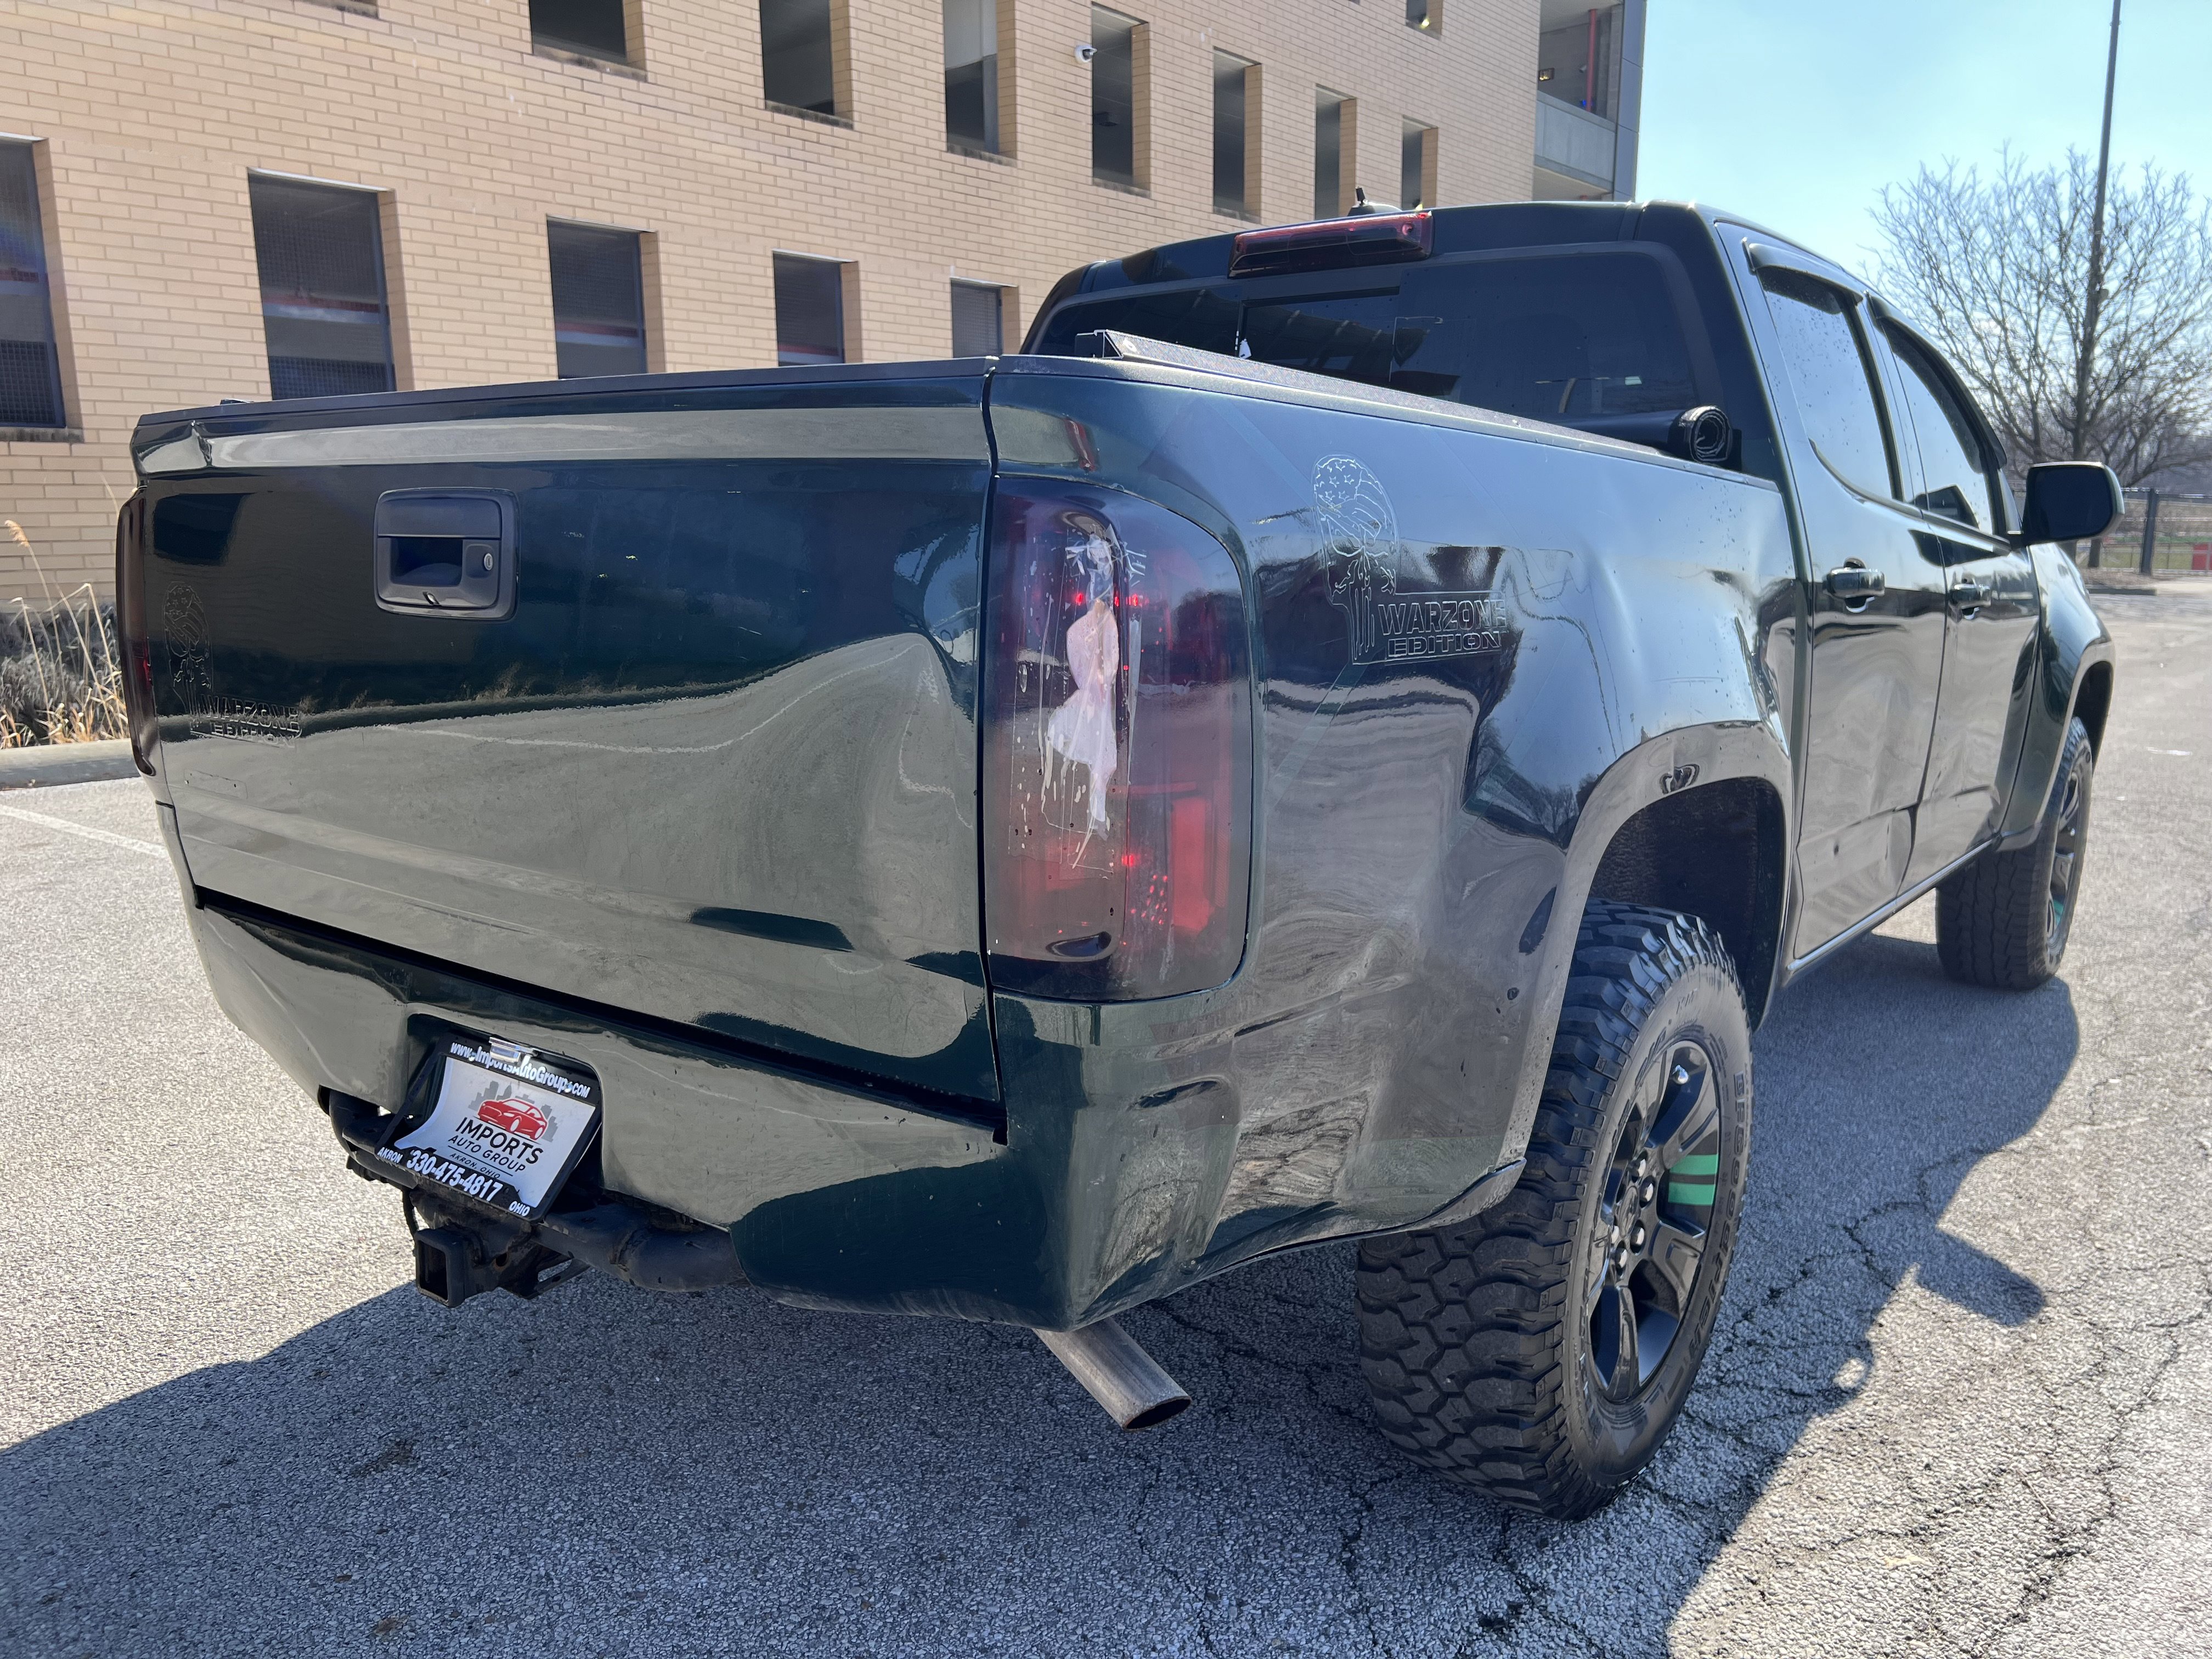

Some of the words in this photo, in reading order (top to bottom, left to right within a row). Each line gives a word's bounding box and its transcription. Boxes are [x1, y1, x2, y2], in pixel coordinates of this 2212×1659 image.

[1378, 599, 1507, 636] WARZONE
[1387, 630, 1502, 658] EDITION
[200, 693, 301, 733] WARZONE
[210, 722, 297, 749] EDITION
[448, 1135, 482, 1153] AUTO
[482, 1149, 526, 1172] GROUP
[455, 1116, 544, 1164] IMPORTS
[377, 1147, 403, 1164] AKRON
[509, 1200, 531, 1217] OHIO
[449, 1153, 478, 1169] AKRON,
[479, 1166, 501, 1178] OHIO
